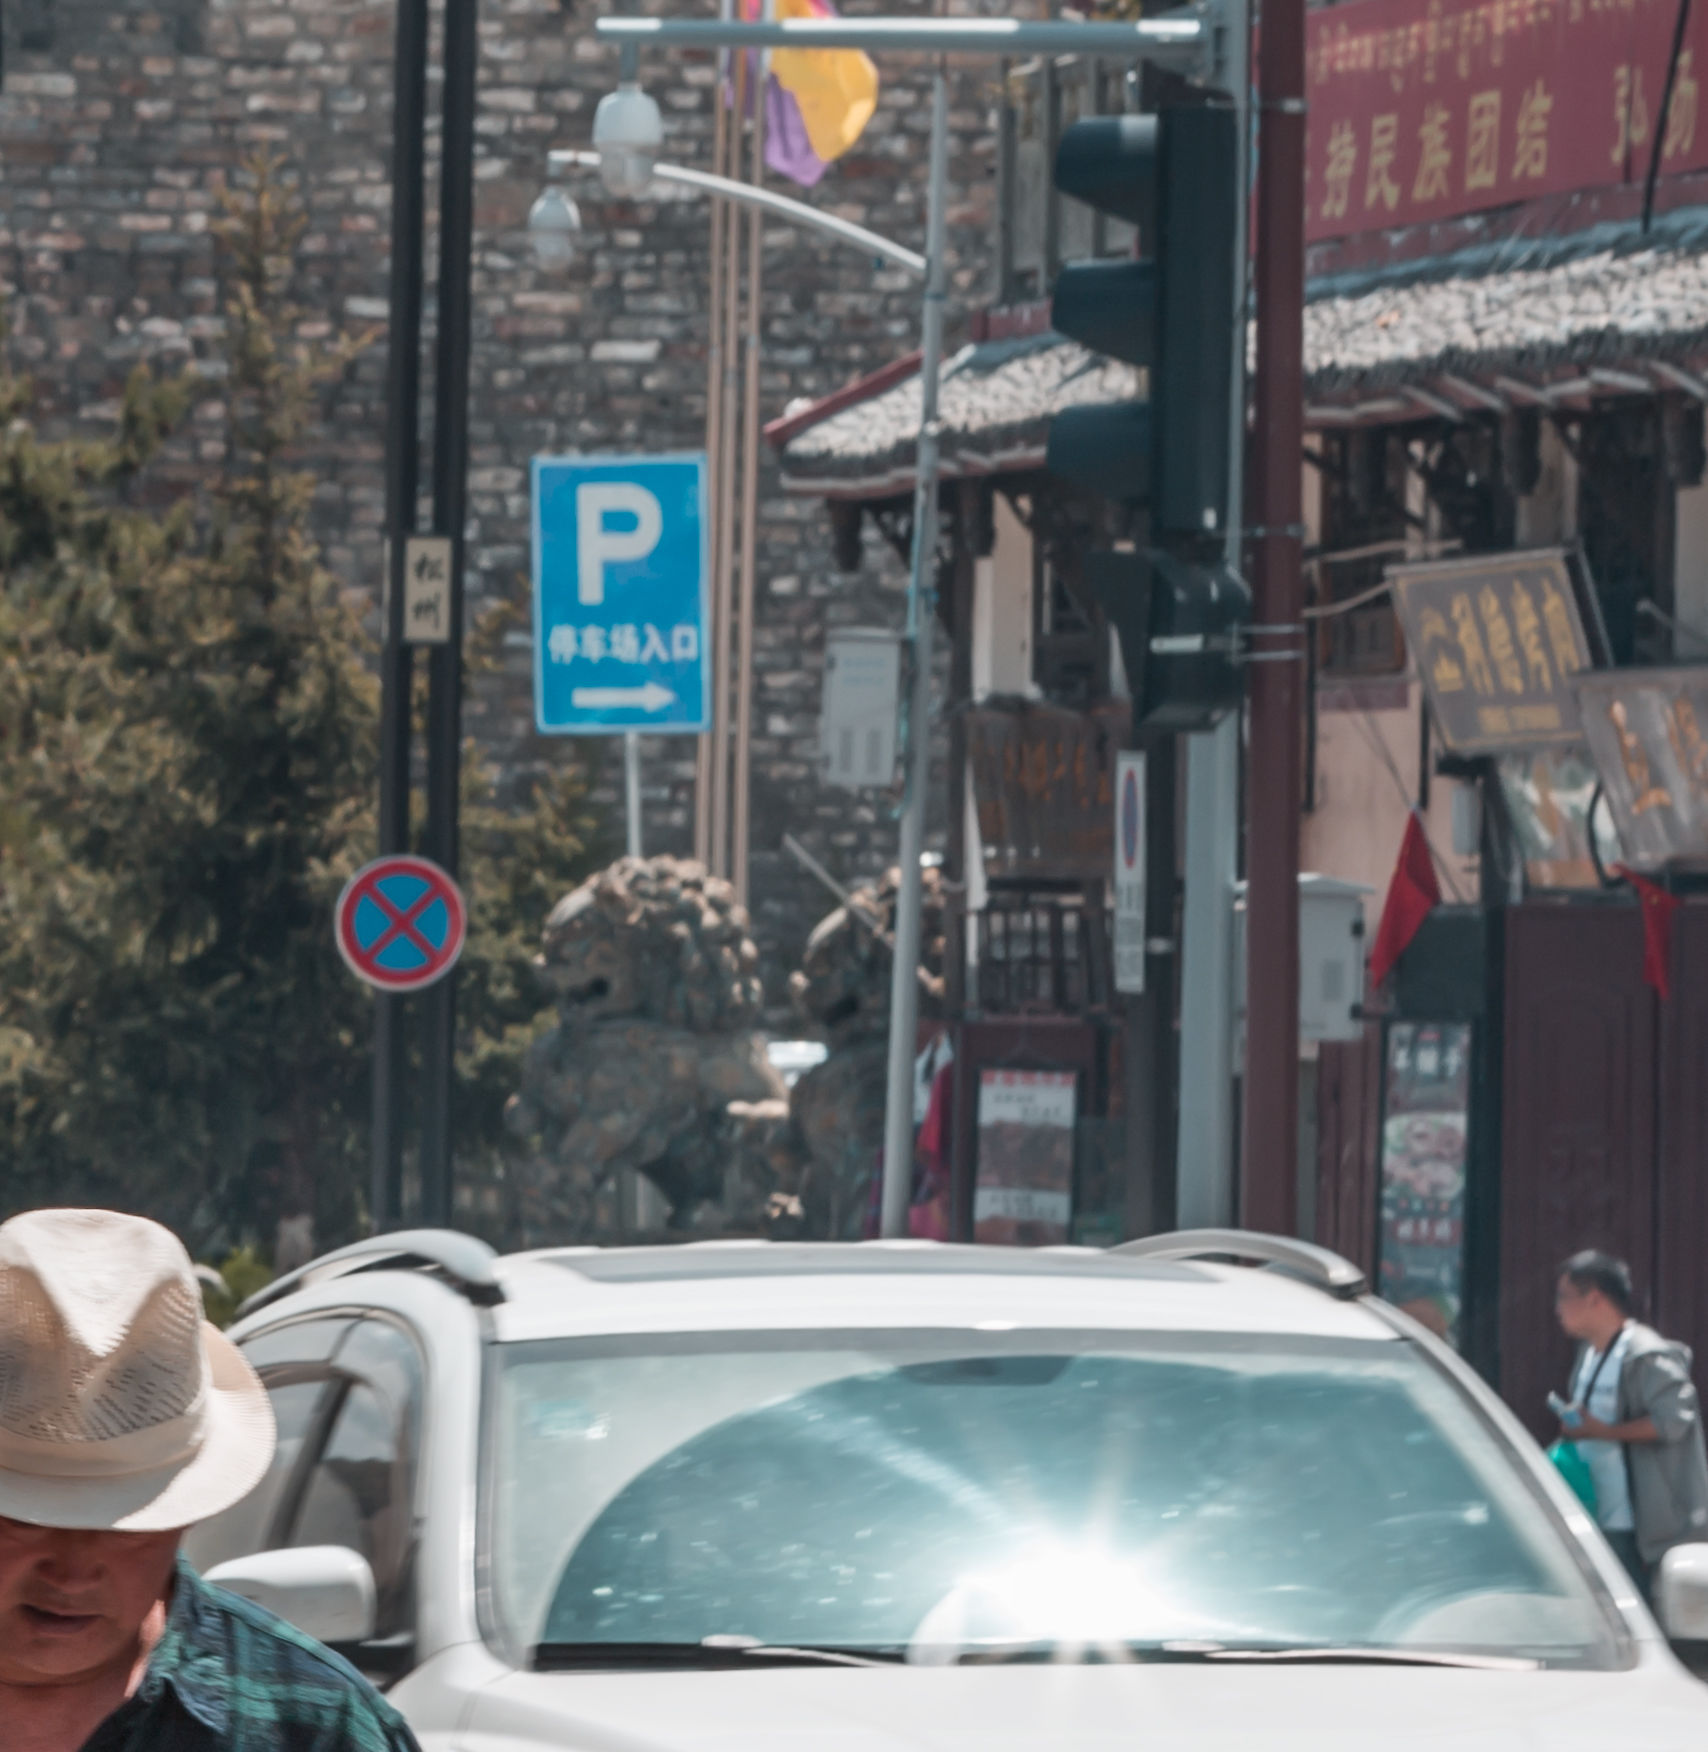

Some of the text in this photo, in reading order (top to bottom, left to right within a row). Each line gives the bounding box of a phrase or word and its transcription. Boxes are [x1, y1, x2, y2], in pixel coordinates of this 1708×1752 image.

[576, 481, 663, 606] P
[547, 623, 699, 664] 停车场入口
